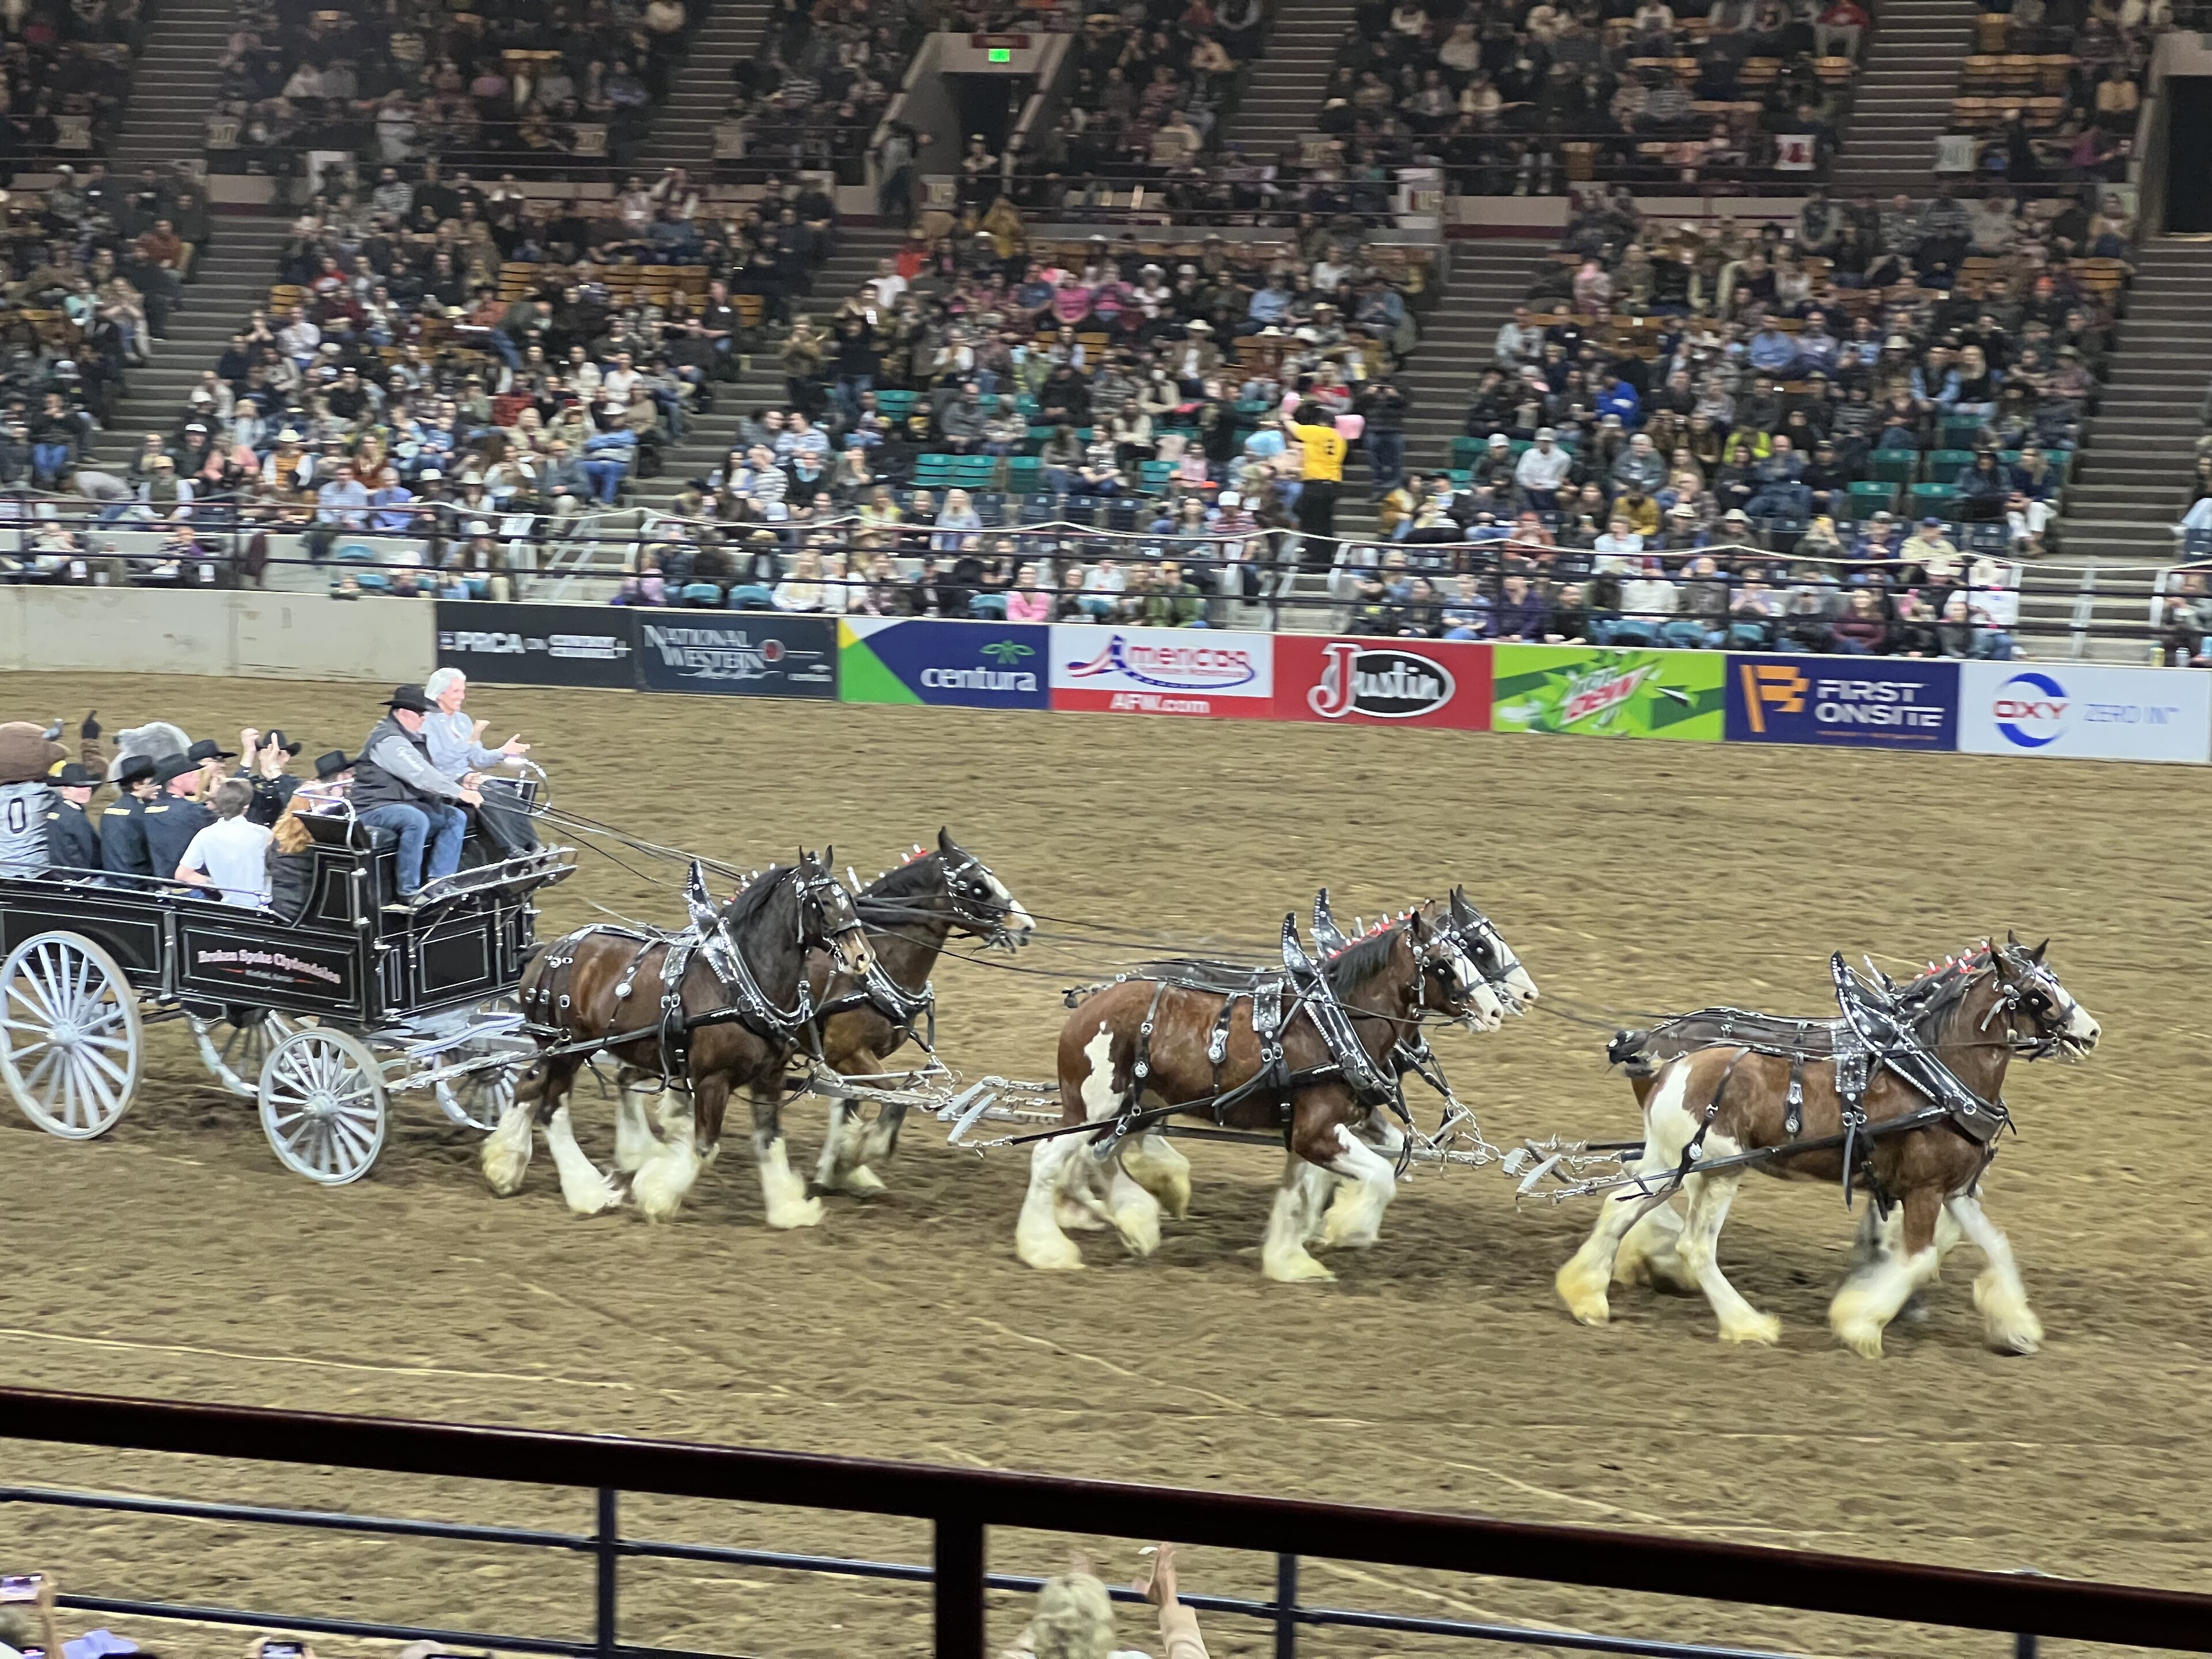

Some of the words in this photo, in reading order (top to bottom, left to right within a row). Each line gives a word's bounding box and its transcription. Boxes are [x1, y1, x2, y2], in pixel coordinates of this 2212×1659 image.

[455, 631, 525, 654] PRCA
[642, 625, 752, 649] NATIONAL
[660, 644, 767, 669] WESTERN
[920, 666, 1038, 692] centura
[1306, 642, 1442, 718] Justin
[1816, 679, 1927, 703] FIRST
[1108, 693, 1210, 714] AFW.com
[1815, 702, 1946, 728] ONSITE
[1992, 700, 2070, 720] OXY
[8, 797, 26, 834] 0
